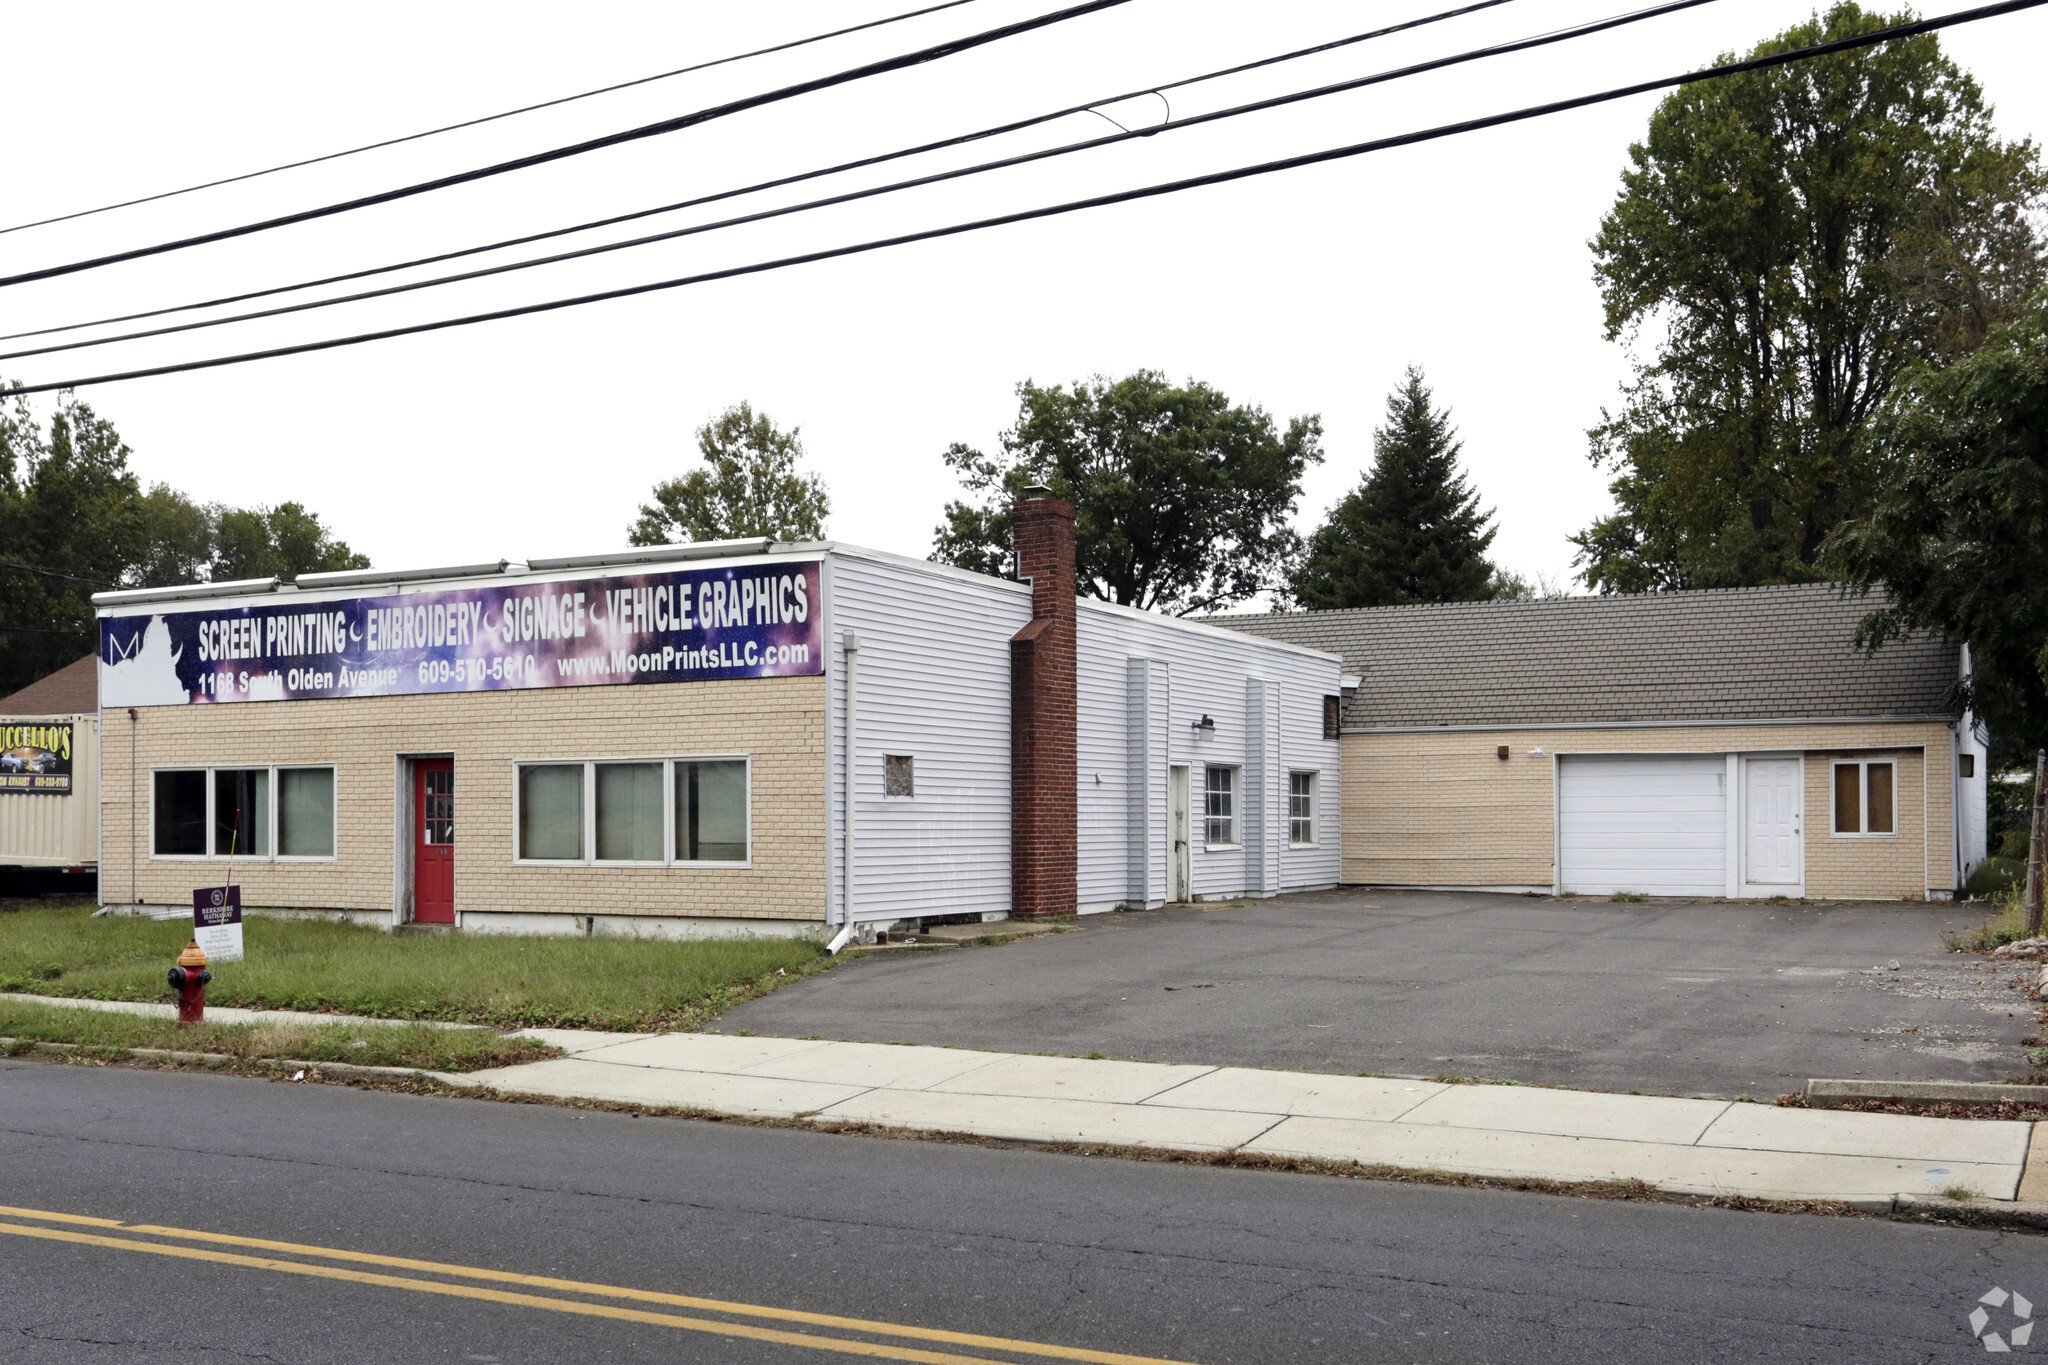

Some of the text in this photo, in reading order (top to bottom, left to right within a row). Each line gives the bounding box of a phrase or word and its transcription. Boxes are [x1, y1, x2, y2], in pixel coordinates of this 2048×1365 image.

[198, 573, 808, 662] SCREEN PRINTING EMBROIDERY SIGNAGE VEHICLE GRAPHICS
[198, 640, 809, 695] 1168 Soth Olden Avenue 609-570-5610 www.MoonPrintsLLC.com
